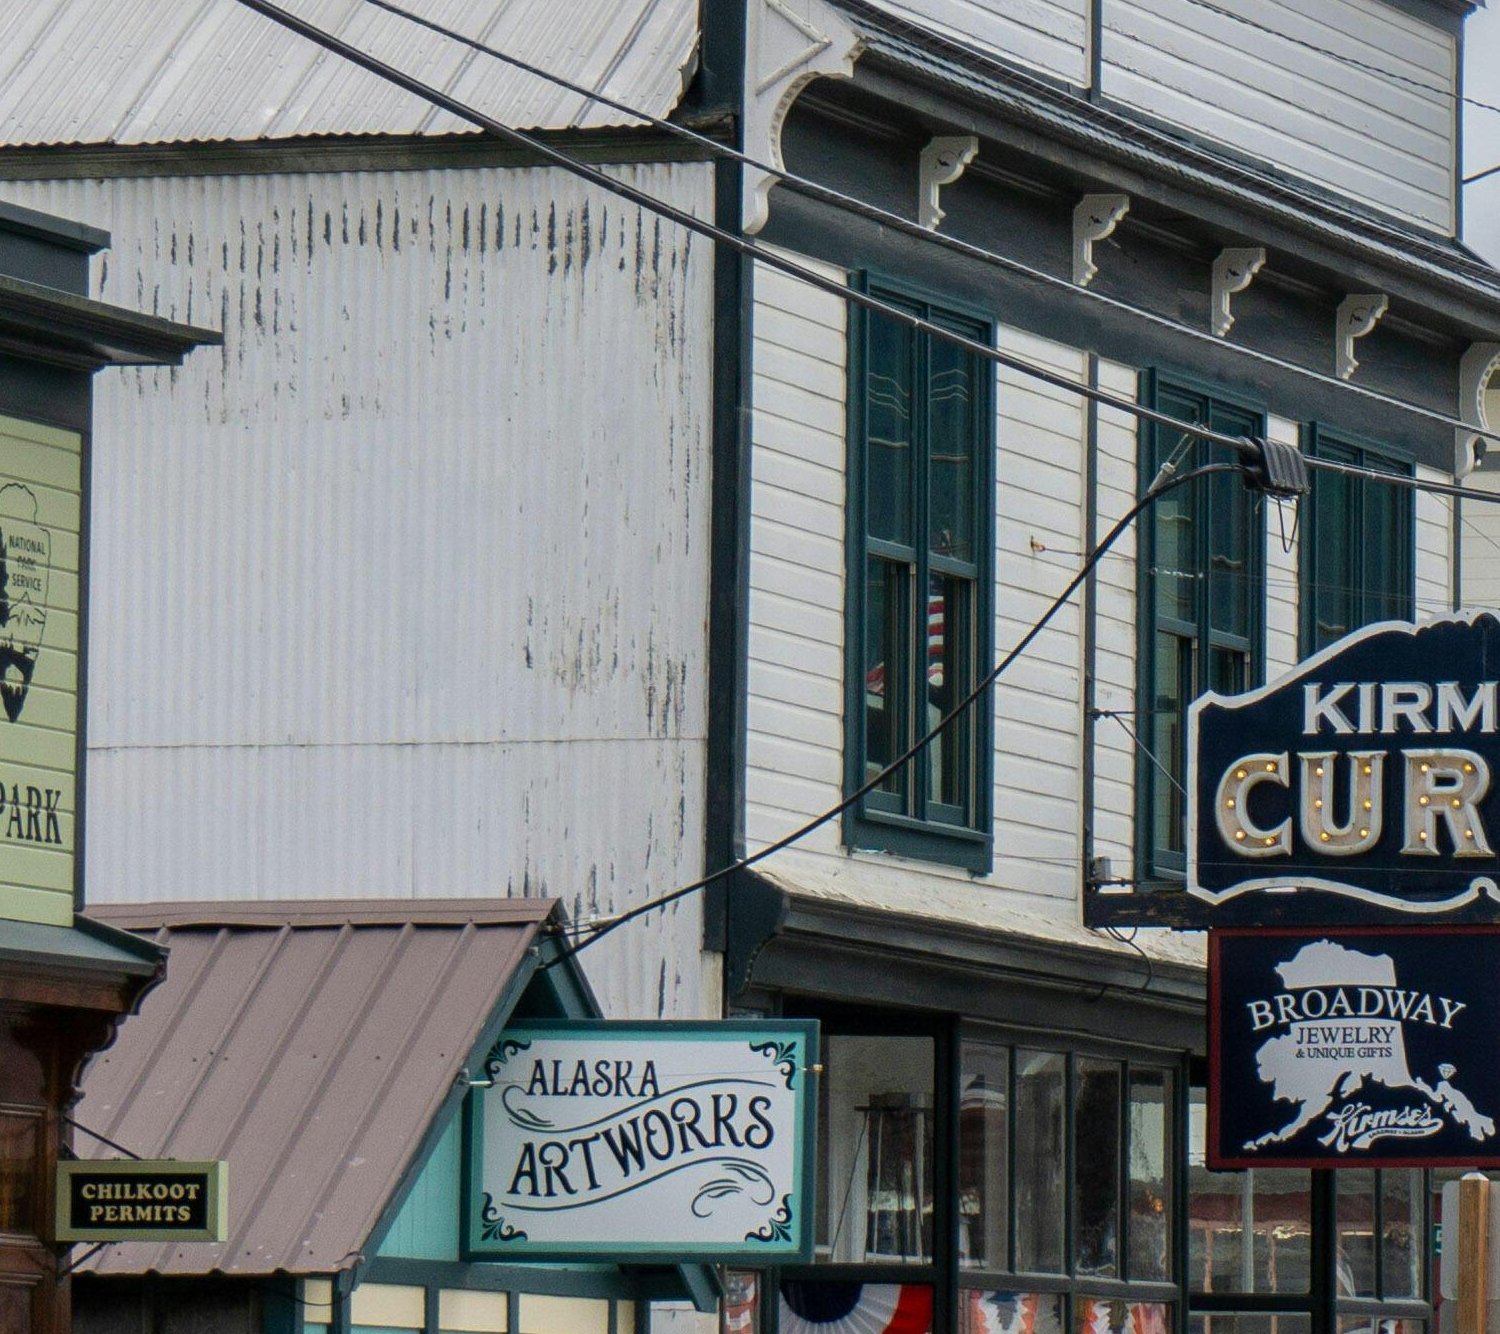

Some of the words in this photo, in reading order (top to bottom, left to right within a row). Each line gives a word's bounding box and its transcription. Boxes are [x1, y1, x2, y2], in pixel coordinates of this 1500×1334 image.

[8, 534, 46, 555] NATIONAL
[12, 573, 42, 592] SERVICE
[1246, 987, 1467, 1031] BROADWAY
[1296, 1027, 1396, 1045] JEWELRY
[1296, 1049, 1305, 1058] &
[1307, 1047, 1355, 1060] UNIQUE
[1357, 1047, 1392, 1058] GIFTS
[527, 1058, 660, 1098] ALASKA
[506, 1093, 775, 1198] ARTWORKS
[81, 1183, 200, 1200] CHILKOOT
[90, 1205, 192, 1222] PERMITS
